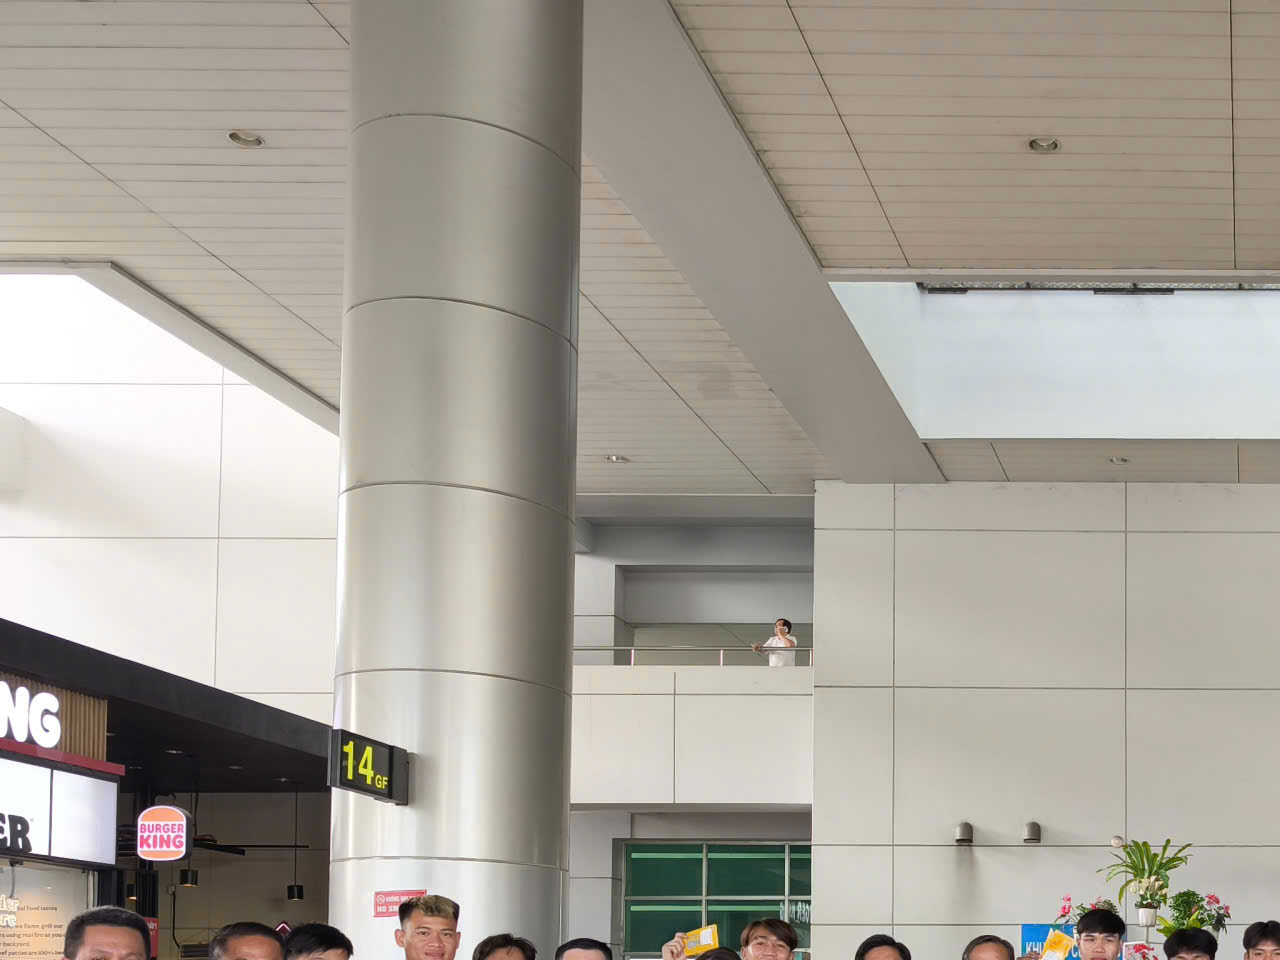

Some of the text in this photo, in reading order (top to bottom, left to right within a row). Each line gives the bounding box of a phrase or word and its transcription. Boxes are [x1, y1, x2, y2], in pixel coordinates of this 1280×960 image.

[343, 741, 389, 789] 14 GF
[140, 823, 185, 834] BURGER
[140, 834, 185, 849] KING
